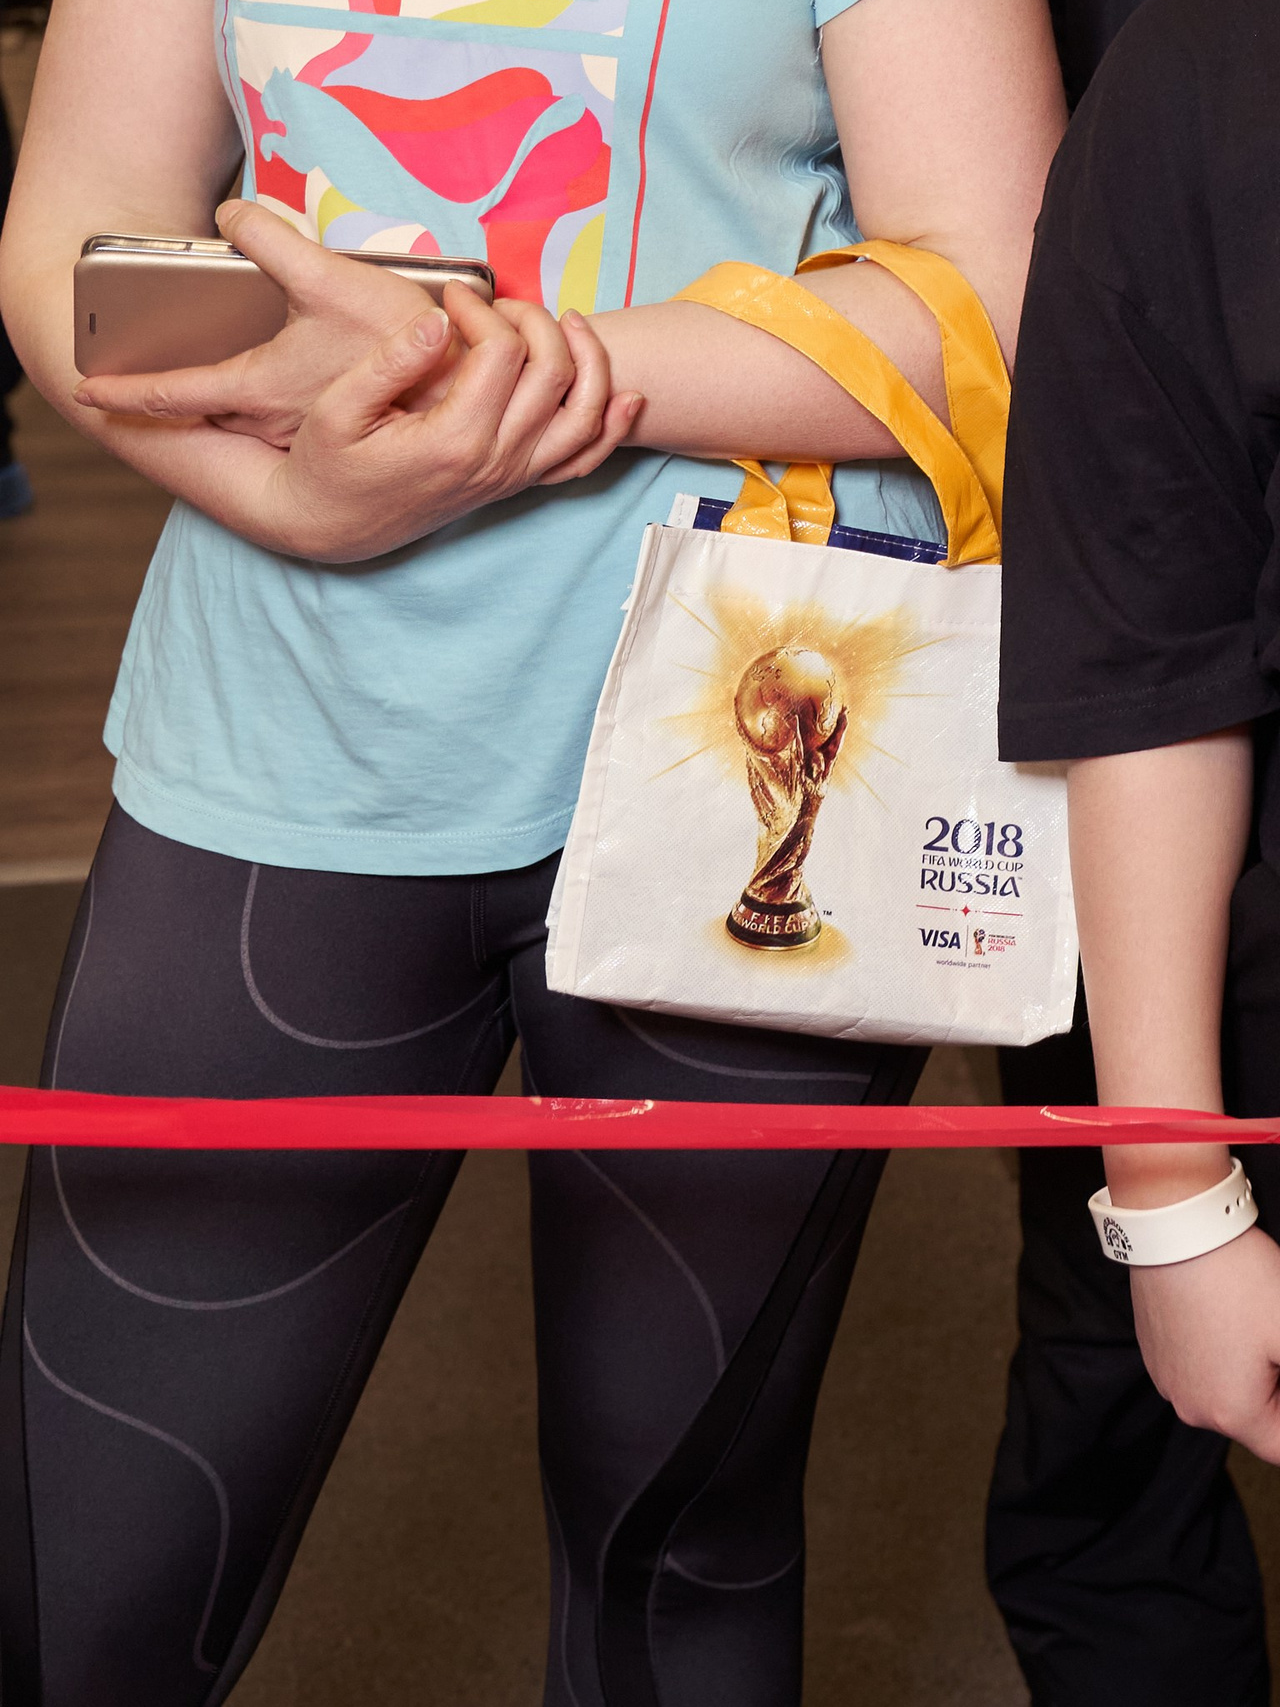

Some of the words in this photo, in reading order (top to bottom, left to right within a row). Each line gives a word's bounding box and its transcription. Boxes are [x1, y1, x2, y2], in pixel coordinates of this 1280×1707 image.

[922, 816, 1024, 858] 2018
[922, 854, 945, 866] FIFA
[996, 860, 1024, 873] CUP
[920, 868, 1021, 898] RUSSIA
[742, 919, 780, 934] WORLD
[784, 921, 809, 934] CUP
[750, 911, 796, 925] FIFA
[918, 928, 960, 949] VISA
[988, 939, 1016, 947] RUSSIA
[1114, 1250, 1129, 1261] GYM
